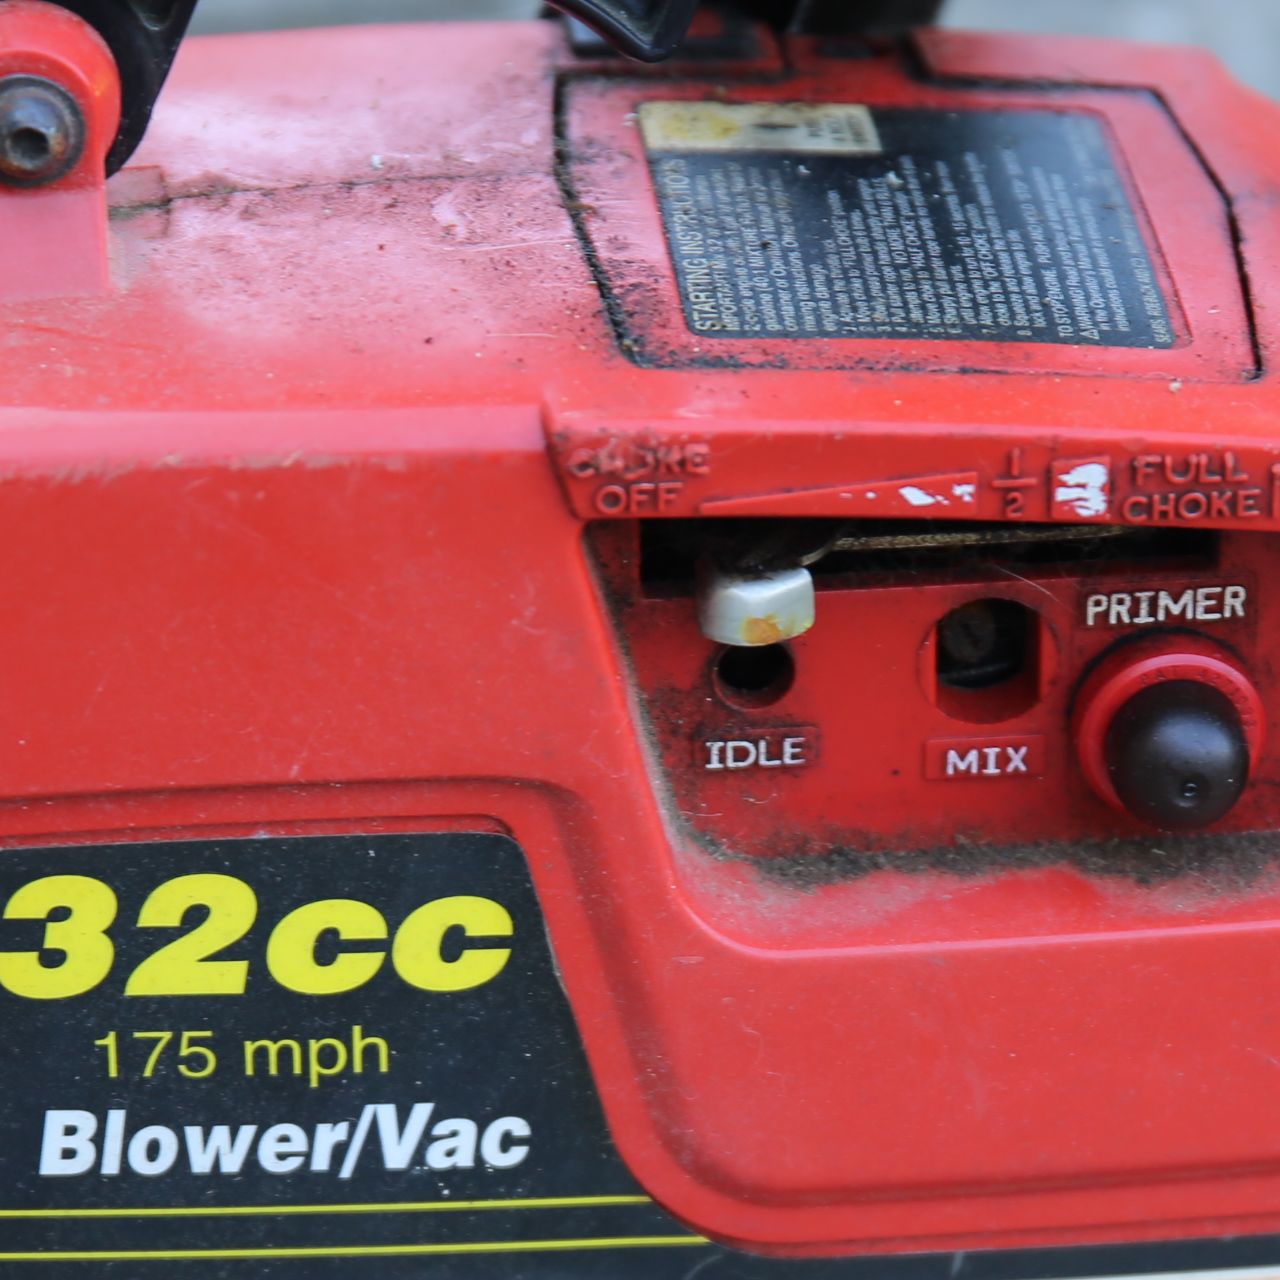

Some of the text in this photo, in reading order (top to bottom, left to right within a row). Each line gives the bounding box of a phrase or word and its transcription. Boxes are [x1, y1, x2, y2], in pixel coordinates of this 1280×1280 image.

[682, 257, 719, 330] STARTING
[1133, 453, 1250, 486] FULL
[595, 481, 684, 516] OFF
[1122, 488, 1262, 525] CHOKE
[1087, 587, 1247, 626] PRIMER
[705, 737, 806, 770] IDLE
[946, 747, 1028, 776] MIX
[94, 1026, 390, 1087] 175 mph
[39, 1103, 532, 1179] Blower/Vac
